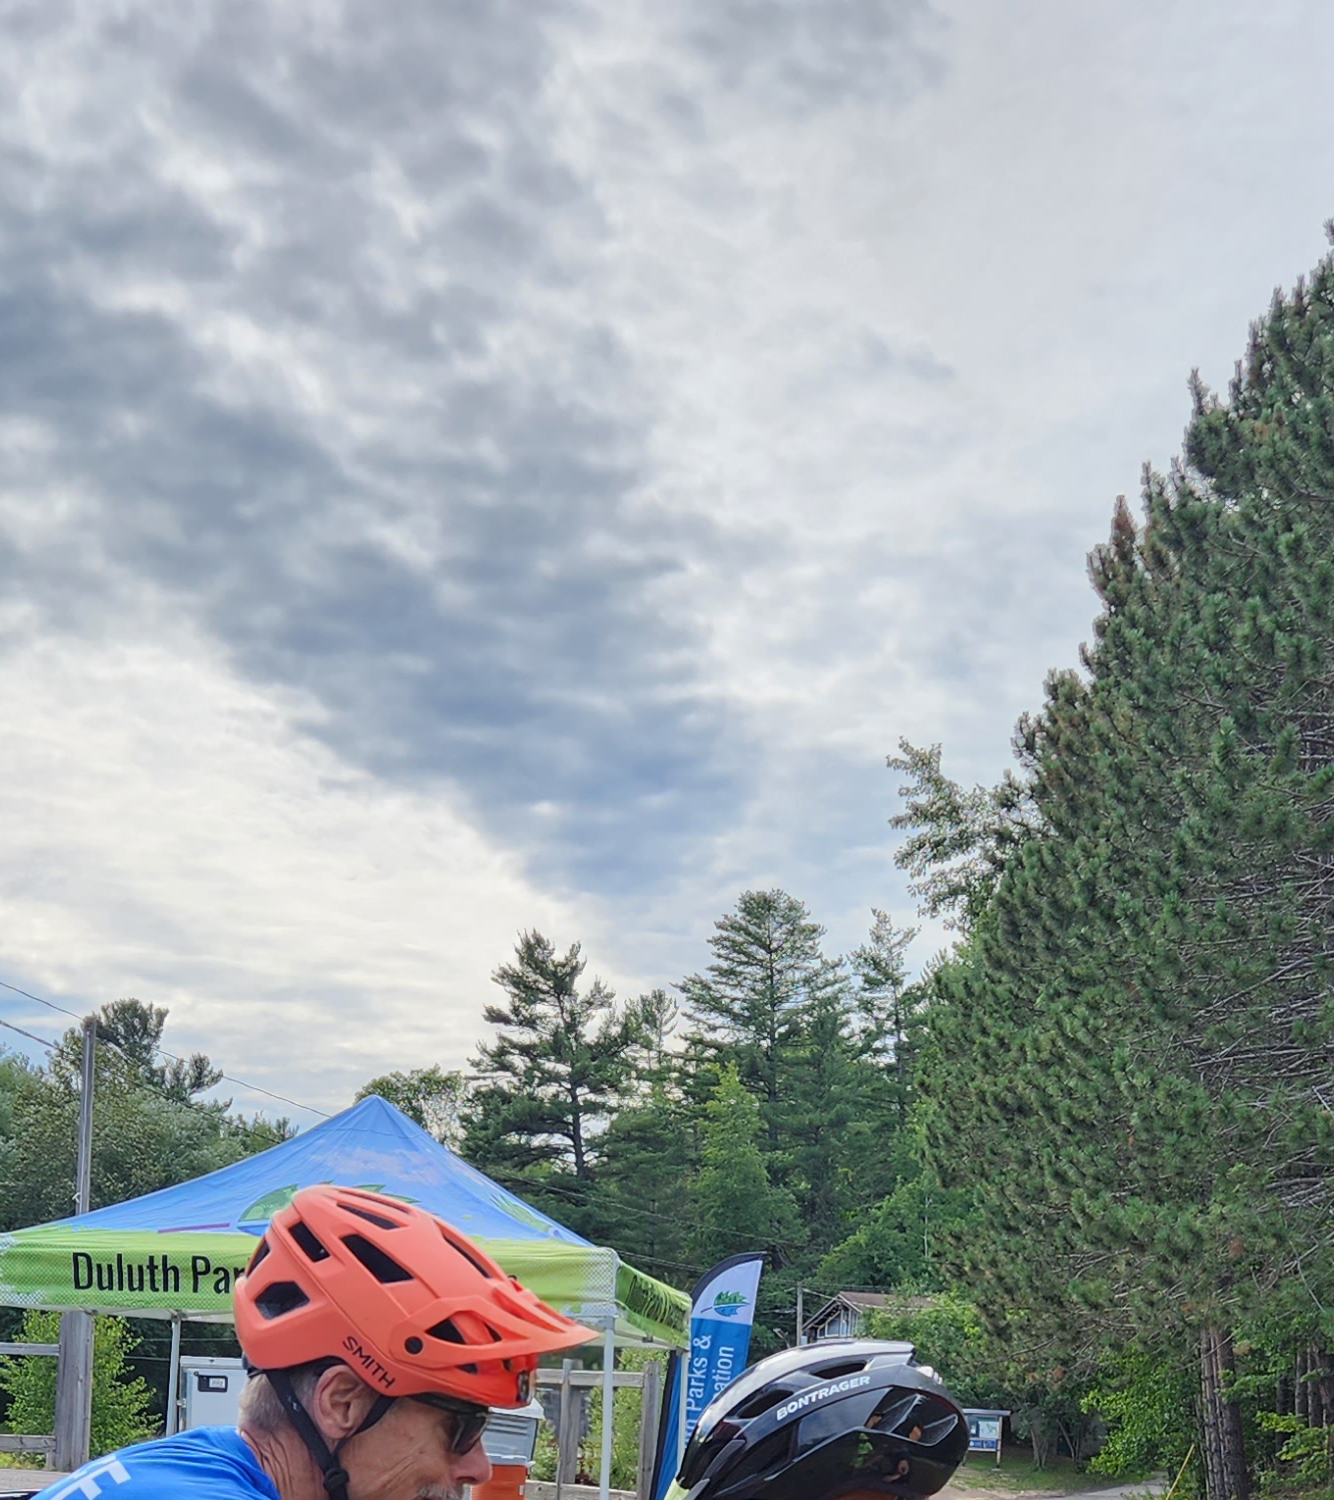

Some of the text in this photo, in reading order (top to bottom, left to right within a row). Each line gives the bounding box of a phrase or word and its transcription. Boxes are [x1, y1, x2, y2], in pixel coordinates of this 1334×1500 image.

[72, 1251, 246, 1295] Duluth Par
[342, 1335, 396, 1389] SMITH
[692, 1334, 712, 1350] &
[686, 1357, 708, 1411] Parks
[712, 1346, 735, 1398] ation
[776, 1375, 871, 1421] BONTRAGER
